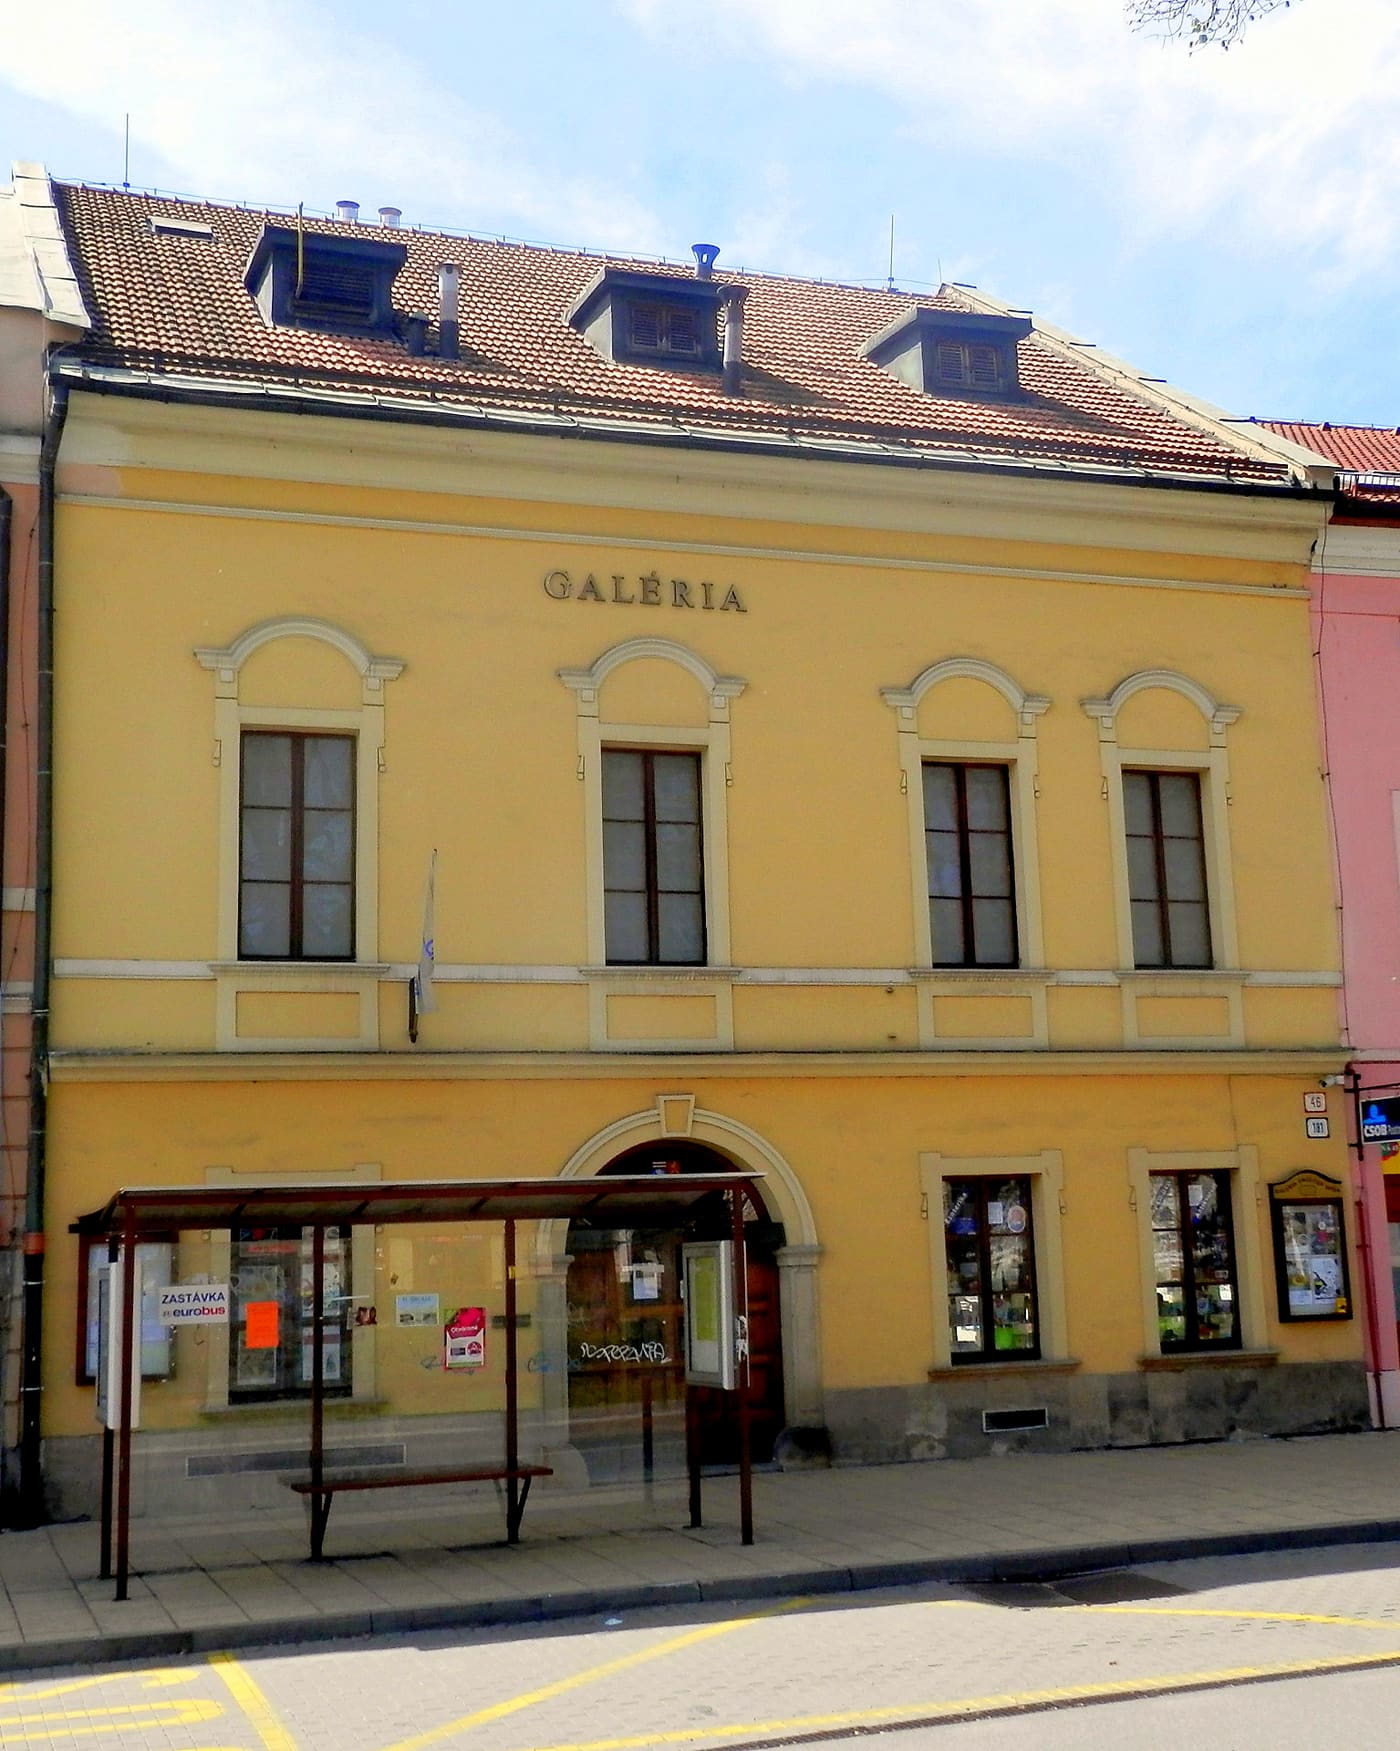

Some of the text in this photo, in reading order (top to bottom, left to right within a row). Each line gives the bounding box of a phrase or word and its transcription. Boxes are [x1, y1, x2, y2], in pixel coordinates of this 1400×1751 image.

[544, 570, 748, 612] GALÉRIA
[1310, 1096, 1322, 1108] 46
[162, 1291, 225, 1304] ZASTÁVKA
[173, 1306, 225, 1317] eurobus
